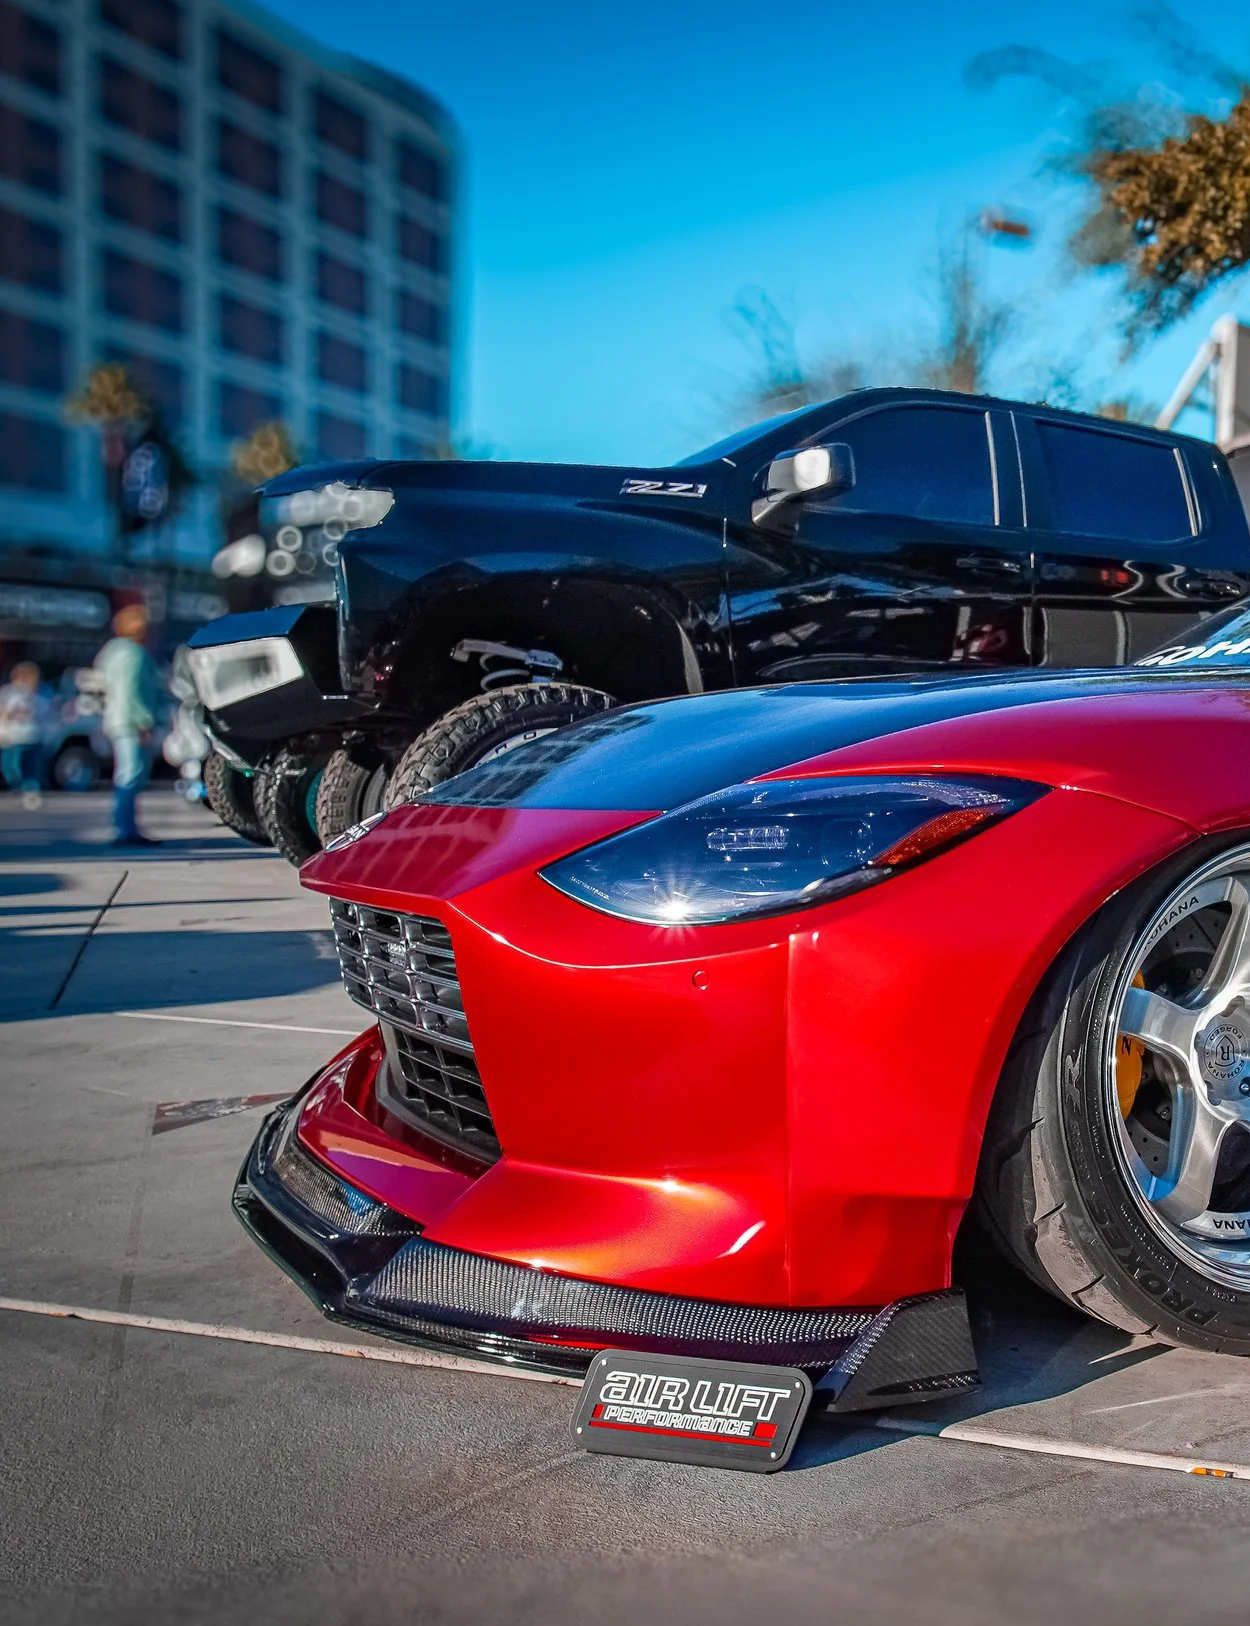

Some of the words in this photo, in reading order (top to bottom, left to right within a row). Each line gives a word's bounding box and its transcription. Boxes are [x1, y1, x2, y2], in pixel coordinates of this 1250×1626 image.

[1143, 895, 1200, 951] OHANA
[1209, 1025, 1243, 1042] FORGED
[1207, 1058, 1245, 1079] ROHANA
[690, 1380, 792, 1421] LIFT
